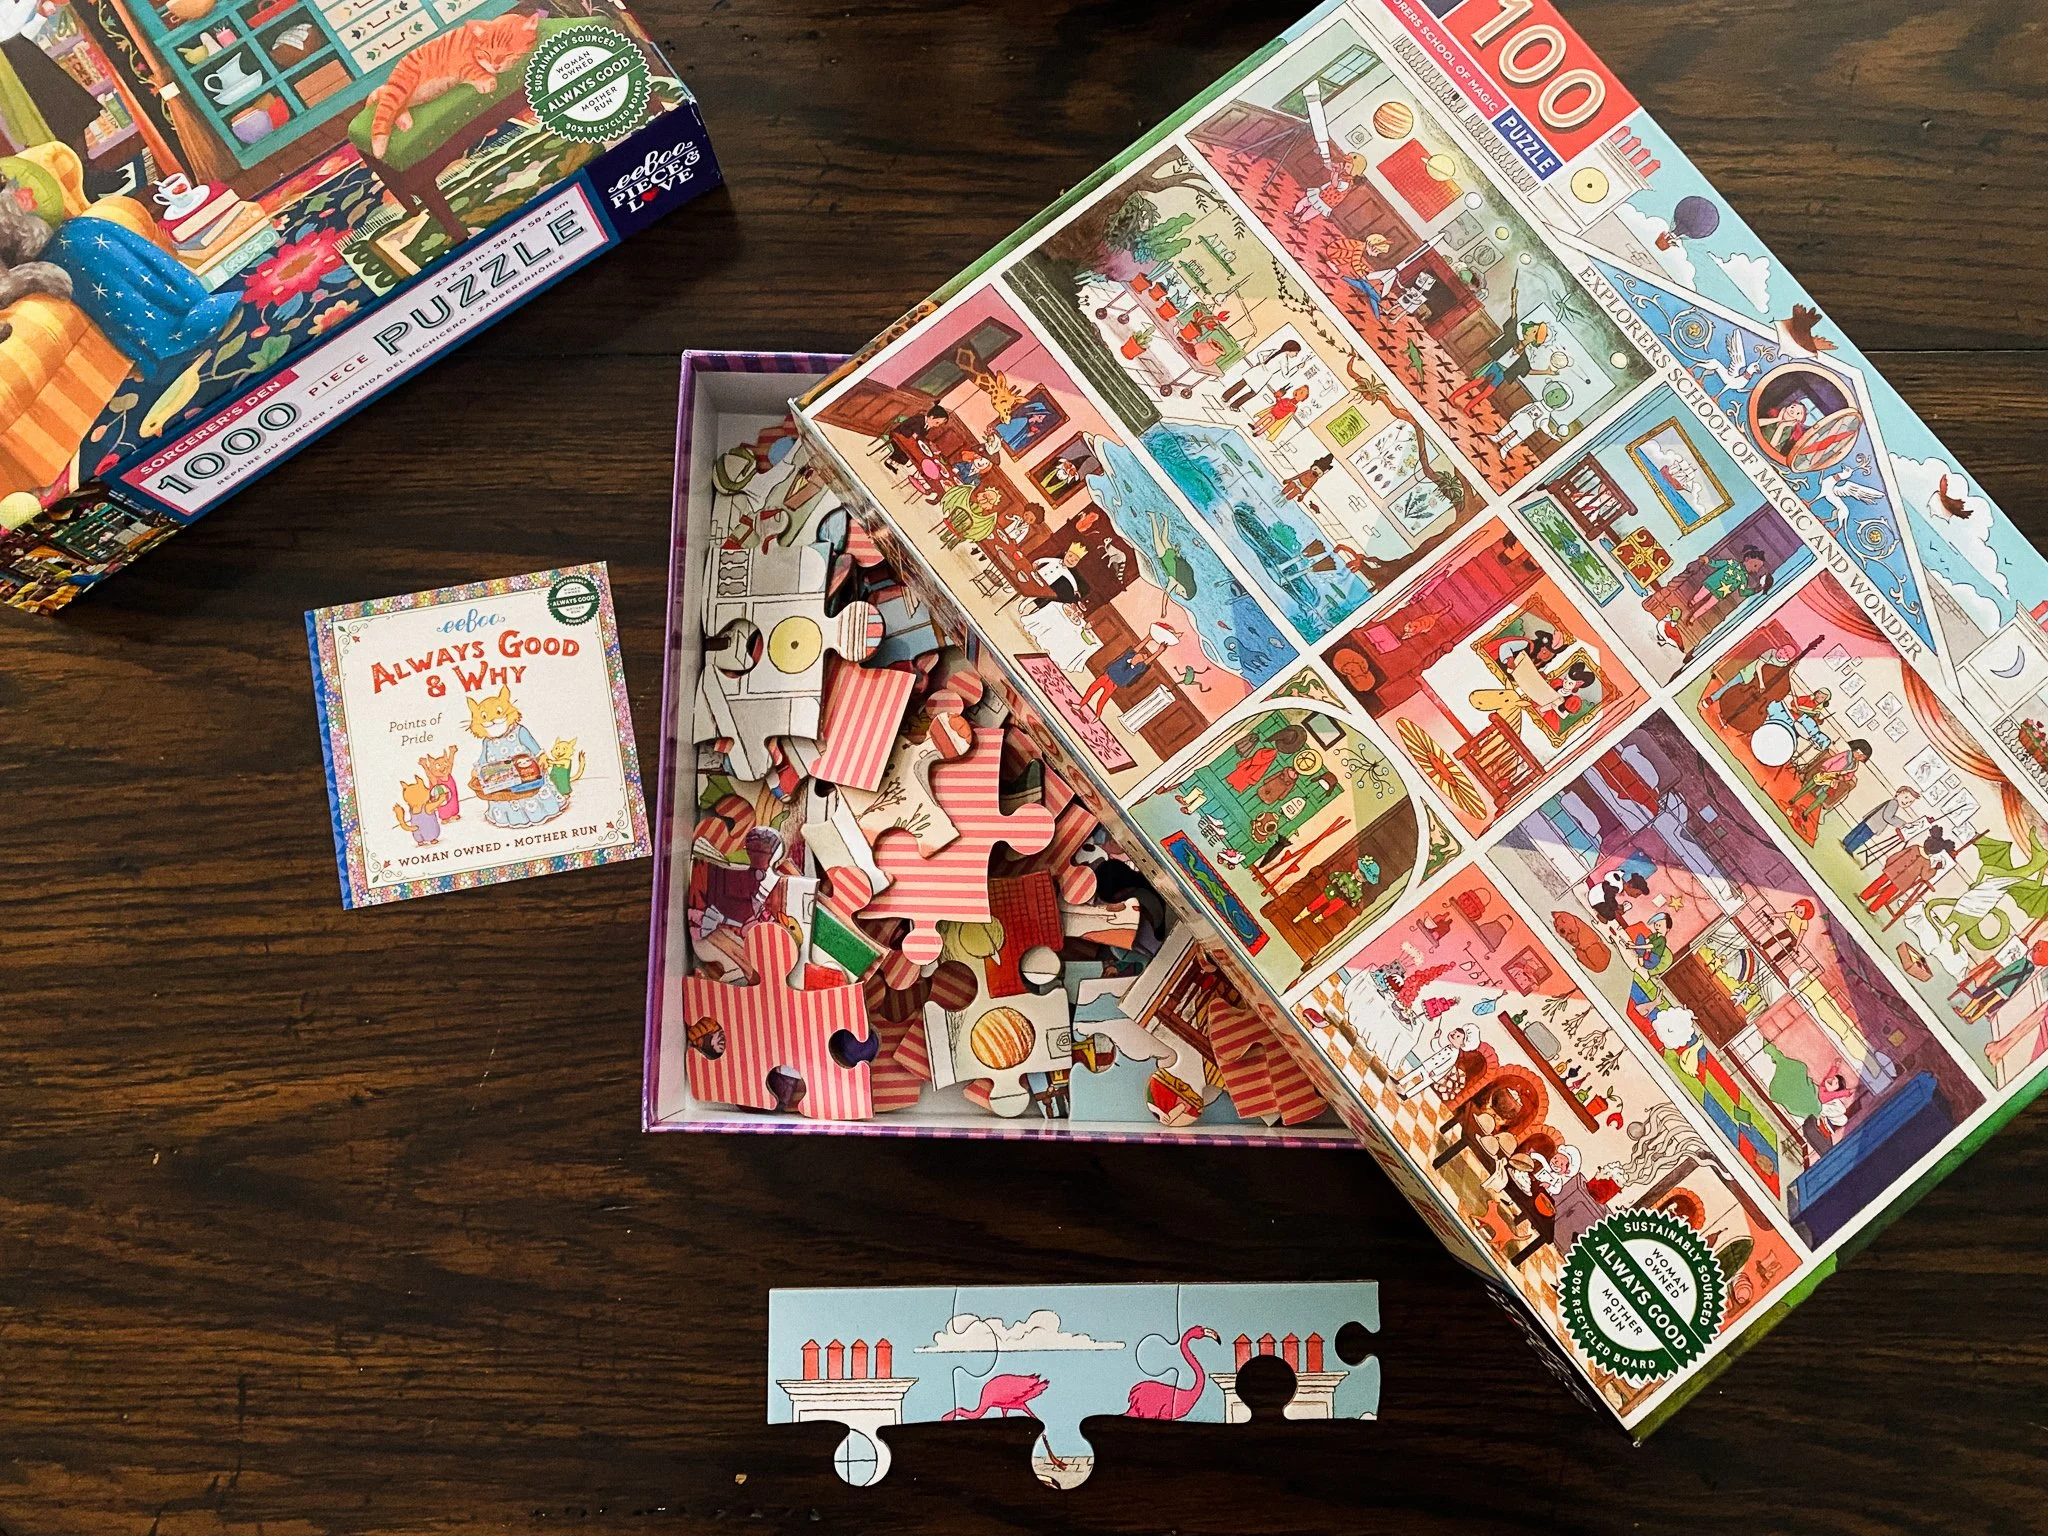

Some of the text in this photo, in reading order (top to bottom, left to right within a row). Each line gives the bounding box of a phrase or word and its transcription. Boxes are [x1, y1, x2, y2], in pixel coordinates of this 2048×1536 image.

[534, 35, 616, 91] SUSTAINABLY SOURCED
[548, 58, 630, 113] ALWAYS GOOD
[556, 51, 590, 74] WOMAN
[561, 57, 594, 80] OWNED
[1420, 26, 1457, 67] SCHOOL
[1455, 65, 1472, 80] OF
[1467, 79, 1499, 112] MAGIC
[1470, 0, 1606, 128] 100
[581, 86, 618, 112] MOTHER
[587, 110, 630, 133] RECYCLED
[629, 80, 642, 110] BOARD
[594, 98, 613, 113] RUN
[1500, 115, 1555, 174] PUZZLE
[610, 150, 700, 209] PIECE &
[434, 277, 449, 287] 23
[459, 261, 474, 272] 23
[475, 254, 486, 262] in
[493, 233, 518, 249] 58.4
[528, 211, 551, 228] 58.4
[554, 200, 569, 211] cm
[157, 209, 586, 495] 1000 PIECE PUZZLE
[140, 381, 281, 476] SORCERER'S DEN
[217, 455, 262, 486] REPAIRE
[264, 443, 279, 455] DU
[281, 411, 326, 442] SORCIER
[337, 374, 384, 404] GUARIDA
[386, 358, 407, 373] DEL
[408, 318, 467, 358] HECHICERO
[1577, 264, 1924, 663] EXPLORERS SCHOOL OF MAGIC AND WONDER
[426, 675, 446, 697] &
[389, 712, 443, 733] Points of
[400, 731, 434, 747] Pride
[398, 825, 598, 868] WOMAN OWNED MOTHER RUN
[1595, 1242, 1687, 1350] ALWAYS GOOD
[1624, 1221, 1713, 1326] SUSTAINABLY SOURCED
[1645, 1257, 1680, 1299] OWNED
[1652, 1248, 1689, 1293] WOMAN
[1571, 1269, 1656, 1369] 90% RECYCLED BOARD
[1602, 1288, 1643, 1336] MOTHER
[1602, 1306, 1626, 1332] RUN
